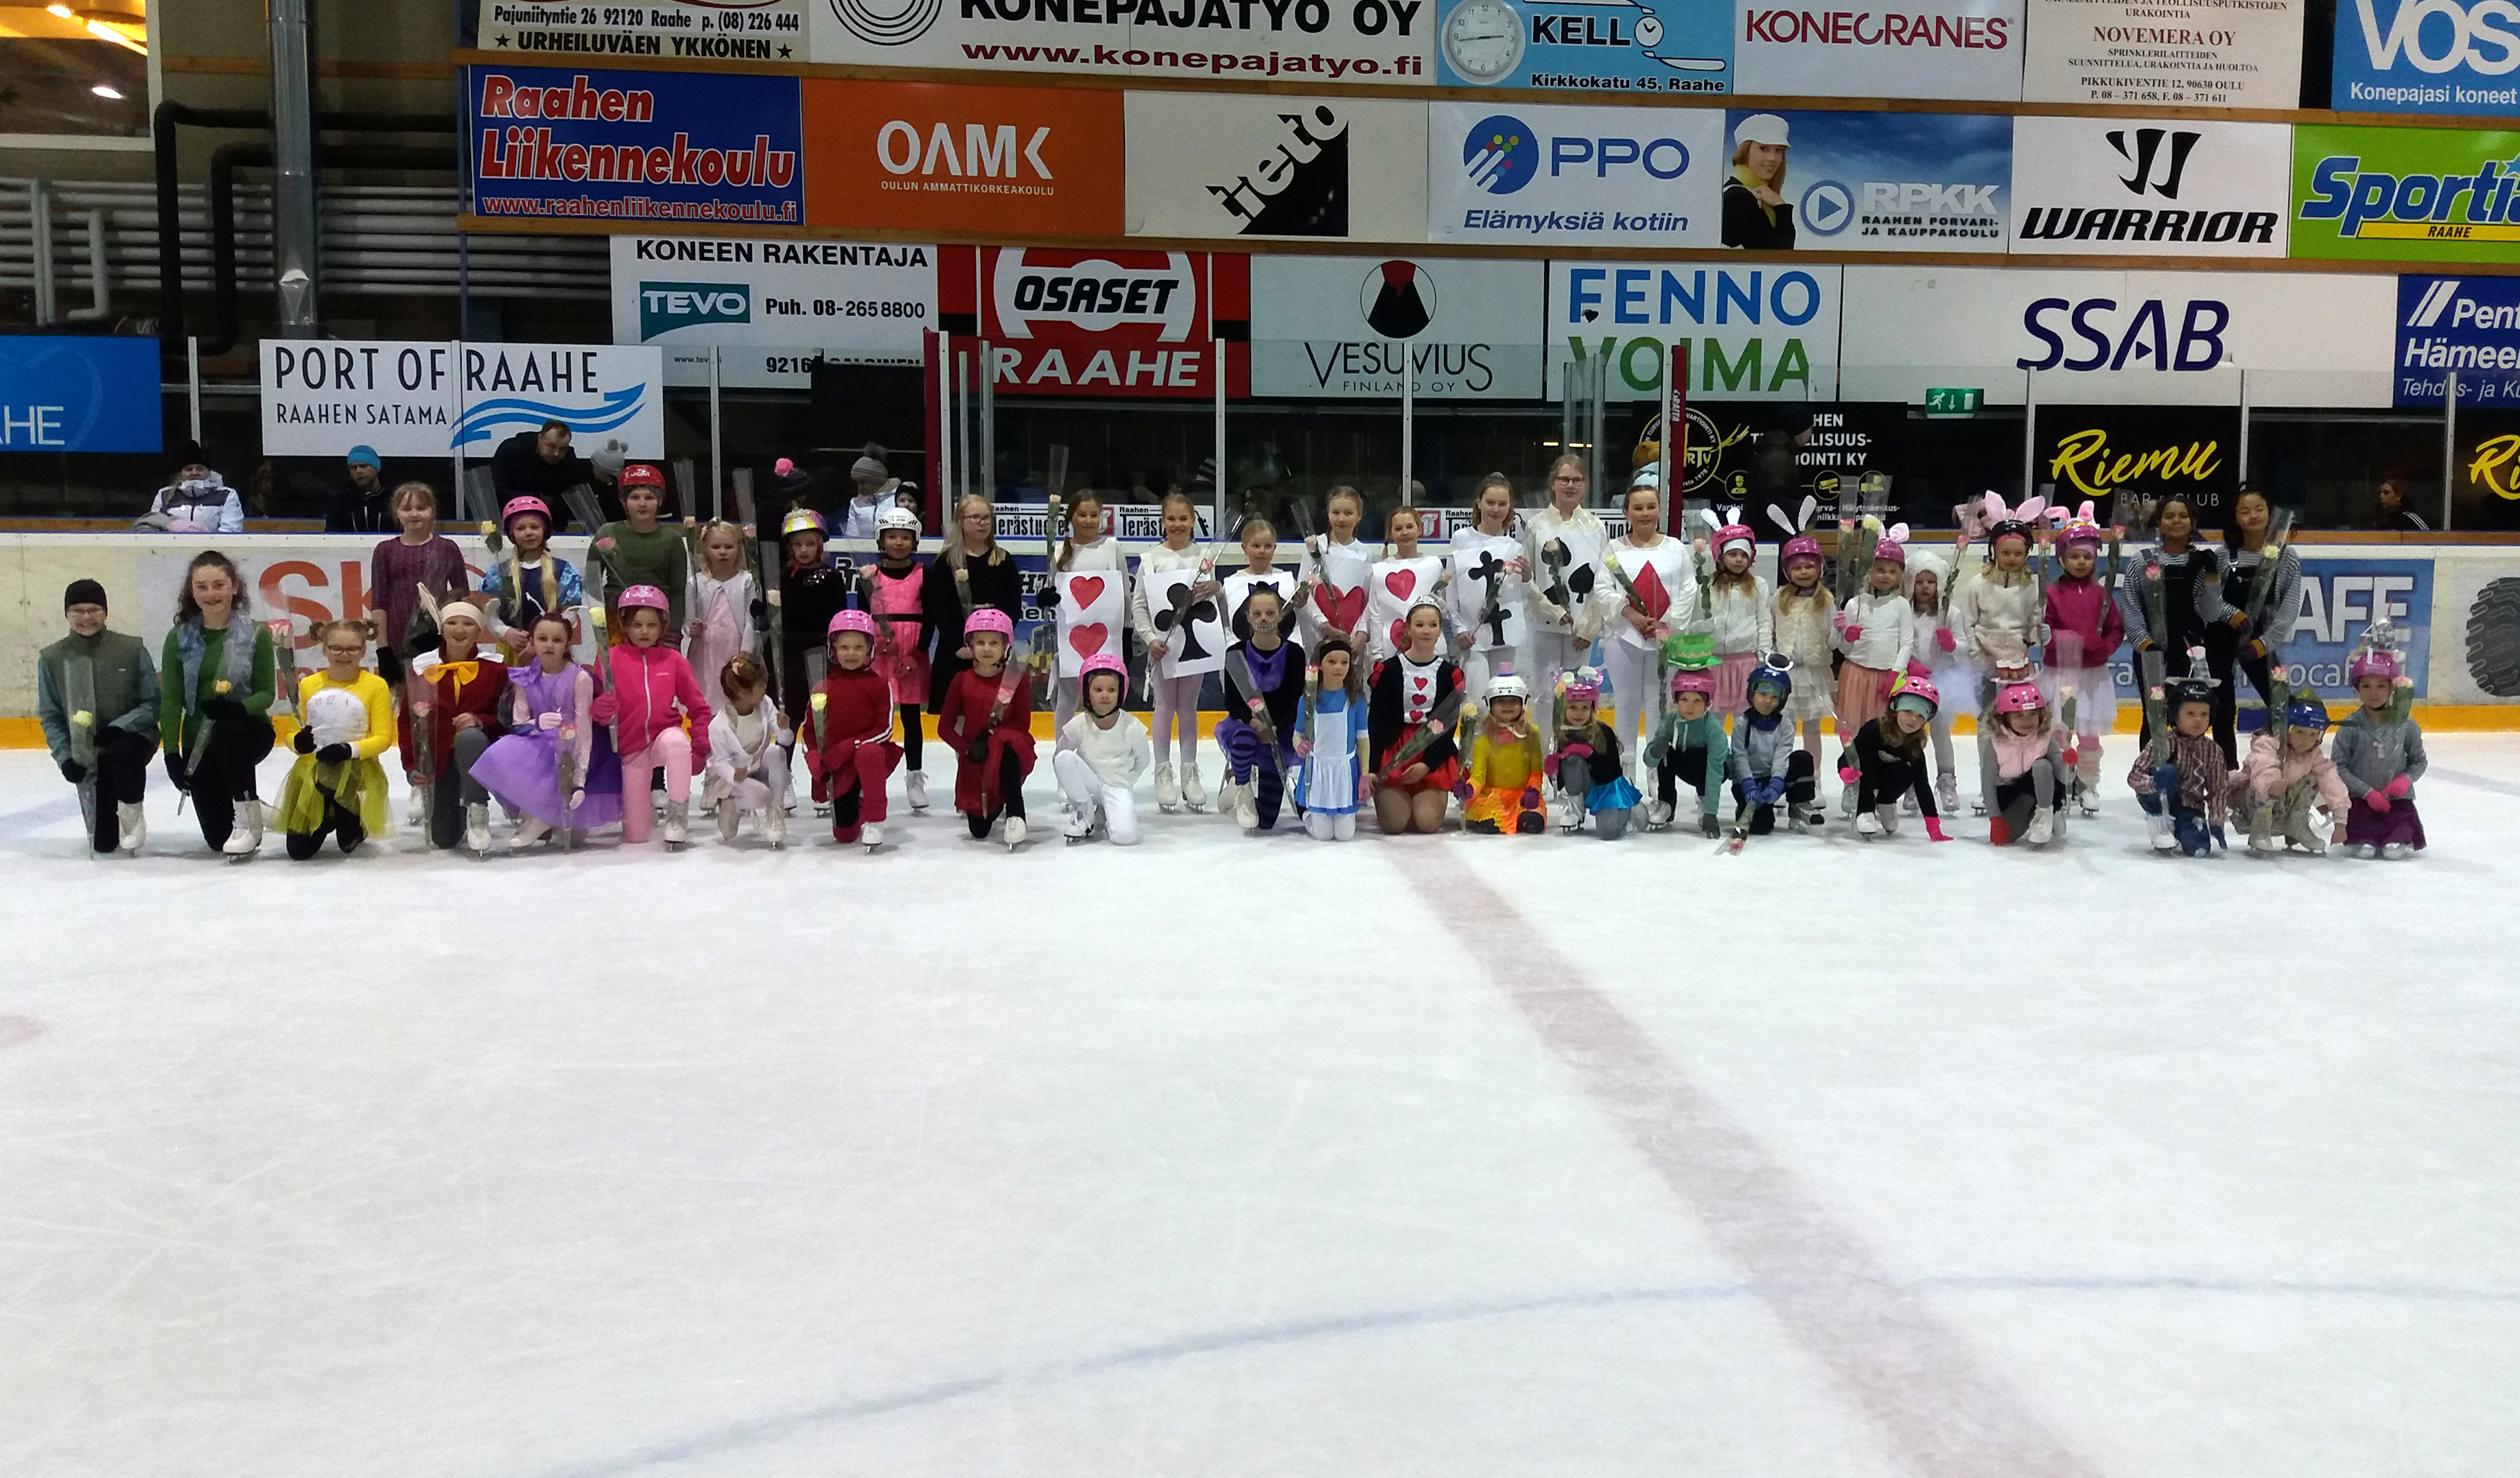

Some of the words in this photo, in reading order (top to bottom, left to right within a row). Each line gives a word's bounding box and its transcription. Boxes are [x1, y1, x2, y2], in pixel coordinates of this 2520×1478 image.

[494, 5, 578, 27] Pajuniityntie
[581, 8, 597, 25] 26
[603, 8, 644, 26] 92120
[651, 10, 691, 28] Raahe
[701, 15, 714, 32] p.
[718, 12, 744, 33] (08)
[747, 12, 772, 32] 226
[775, 13, 799, 32] 444
[1352, 0, 1422, 36] OY
[2125, 8, 2191, 19] URAKOINTIA
[1746, 10, 2008, 50] KONECRANES
[2092, 26, 2204, 46] NOVEMERA
[2209, 30, 2236, 47] OY
[517, 31, 661, 56] URHEILUVÄEN
[672, 33, 771, 60] YKKÖNEN
[961, 44, 1422, 78] www.konepajatyo.fi
[2144, 60, 2202, 70] URAKOINTIA
[2202, 62, 2214, 71] JA
[1530, 73, 1631, 91] Kirkkokatu
[1635, 76, 1663, 92] 45,
[1668, 77, 1725, 92] Raahe
[2080, 76, 2169, 88] PIKKUKIVENTIE
[2186, 79, 2213, 90] 90630
[2215, 80, 2245, 91] OULU
[2090, 90, 2100, 99] P.
[2101, 90, 2113, 100] 08
[2123, 91, 2138, 101] 371
[2162, 92, 2171, 102] F.
[2173, 92, 2184, 102] 08
[2193, 93, 2210, 102] 371
[2212, 93, 2227, 103] 611
[2350, 82, 2450, 104] Konepajasi
[2455, 85, 2517, 104] koneet
[481, 74, 653, 122] Raahen
[480, 126, 795, 188] Liikennekoulu
[877, 120, 1053, 180] OAMK
[1550, 137, 1690, 180] PPO
[881, 181, 919, 191] OULUN
[922, 182, 1055, 196] AMMATTIKORKEAKOULU
[1861, 182, 2000, 215] RPKK
[482, 195, 797, 222] www.raahenliikennekoulu.fi
[1463, 209, 1605, 234] Elämyksiä
[1612, 210, 1688, 232] kotiin
[1861, 215, 1923, 226] RAAHEN
[1929, 216, 2000, 227] PORVARI-
[1860, 226, 1880, 237] JA
[1887, 227, 1999, 238] KAUPPAKOULU
[2019, 207, 2278, 244] WARRIOR
[2427, 225, 2473, 239] RAAHE
[637, 239, 754, 263] KONEEN
[762, 244, 929, 268] RAKENTAJA
[641, 290, 747, 316] TEVO
[765, 298, 808, 316] Puh.
[1013, 275, 1180, 315] OSASET
[1569, 268, 1821, 327] FENNO
[2016, 297, 2230, 372] SSAB
[992, 347, 1201, 387] RAAHE
[1305, 342, 1493, 392] VESUVIUS
[1567, 336, 1817, 392] VOIMA
[2403, 337, 2520, 370] Hämee
[275, 346, 379, 390] PORT
[398, 348, 446, 391] OF
[465, 349, 598, 394] RAAHE
[1431, 382, 1455, 392] OY
[2403, 378, 2473, 397] Tehds-
[2477, 379, 2495, 402] ja
[0, 405, 65, 445] HE
[277, 403, 358, 425] RAAHEN
[366, 403, 447, 426] SATAMA
[1846, 452, 1867, 466] KY
[2049, 429, 2222, 497] Riemu
